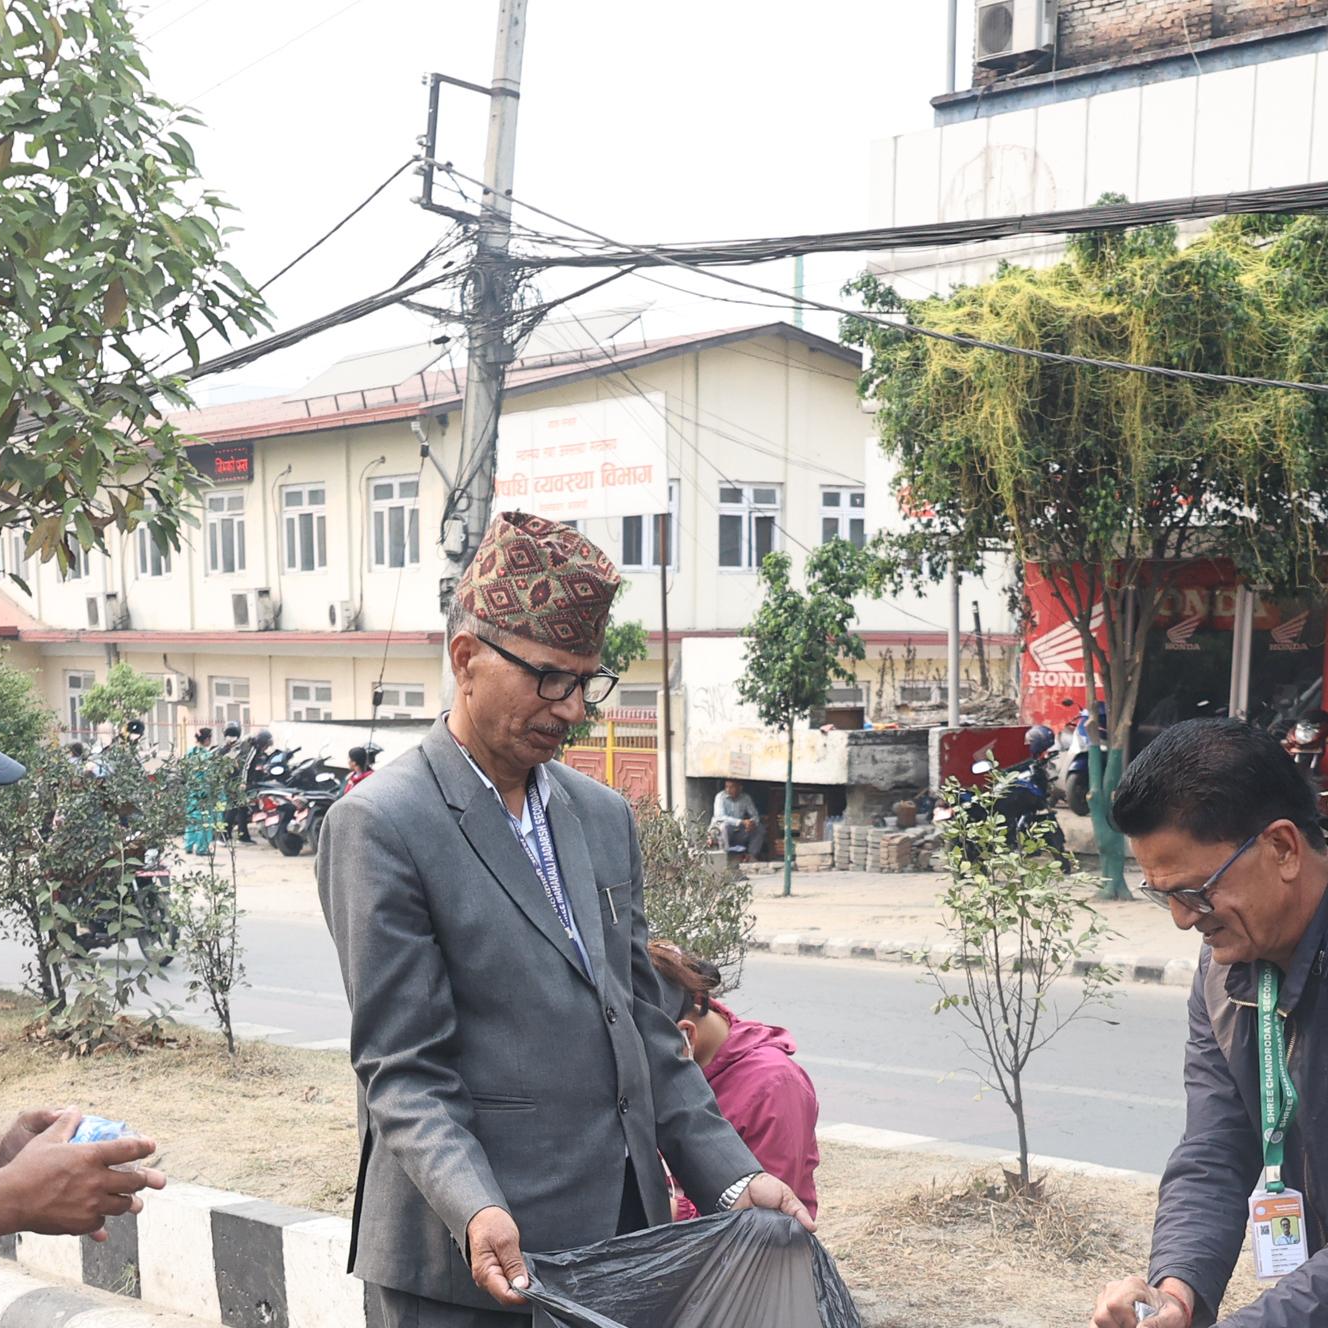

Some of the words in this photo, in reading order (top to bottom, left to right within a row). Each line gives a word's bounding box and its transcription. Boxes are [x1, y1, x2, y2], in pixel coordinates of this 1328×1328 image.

[533, 470, 595, 494] व्यवस्था
[601, 462, 654, 489] विभाग
[533, 824, 556, 867] AADARSH
[541, 863, 566, 906] MAHAKALI
[1263, 1014, 1274, 1088] CHANDRODAYA
[1266, 1090, 1275, 1124] SHREE
[1279, 1097, 1294, 1128] SHREE
